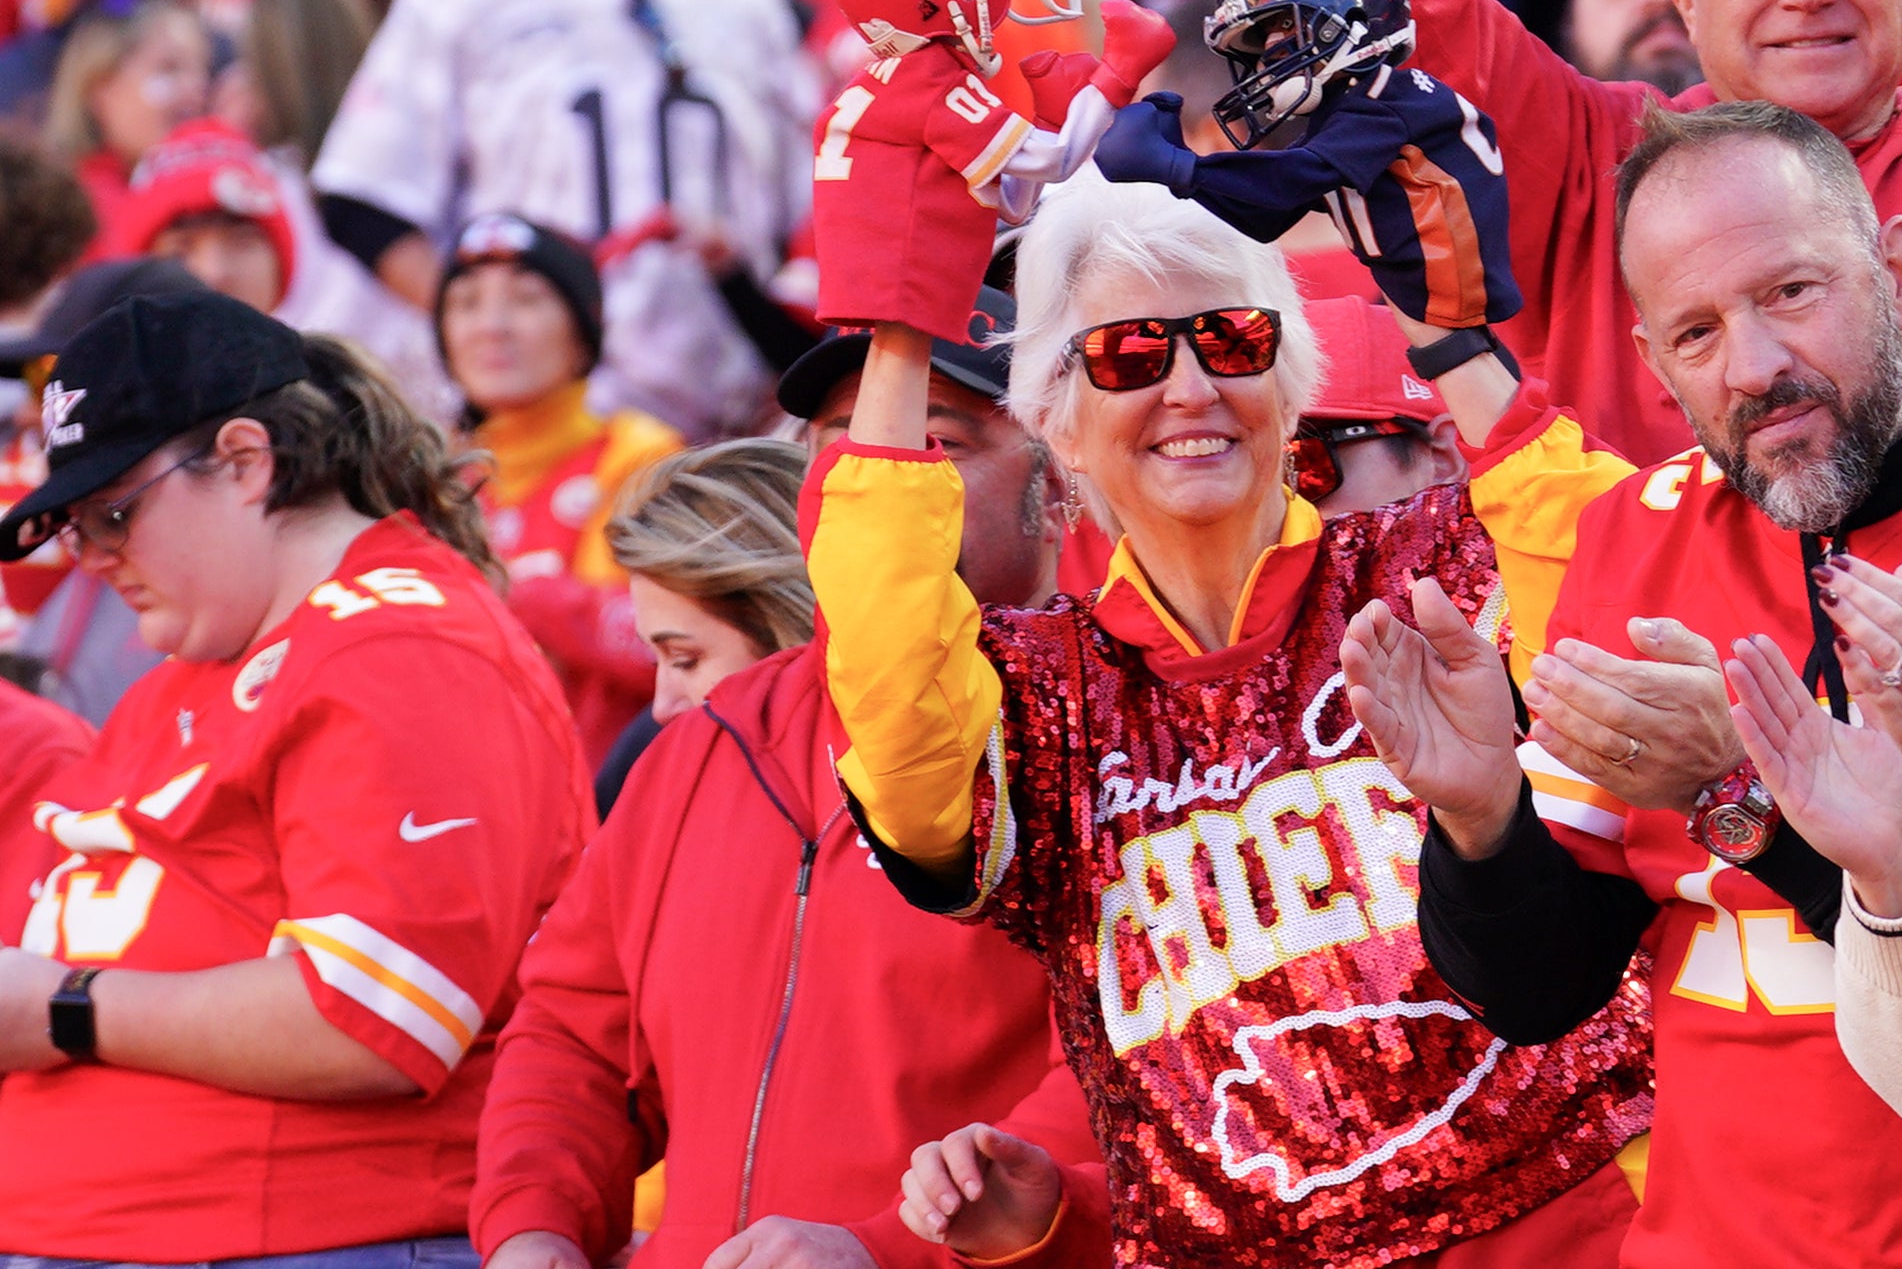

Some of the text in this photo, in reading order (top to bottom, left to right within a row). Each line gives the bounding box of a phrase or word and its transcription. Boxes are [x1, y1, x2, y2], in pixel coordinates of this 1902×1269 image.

[814, 85, 877, 180] 1
[308, 566, 446, 621] 15
[1097, 756, 1425, 1058] CHIEF
